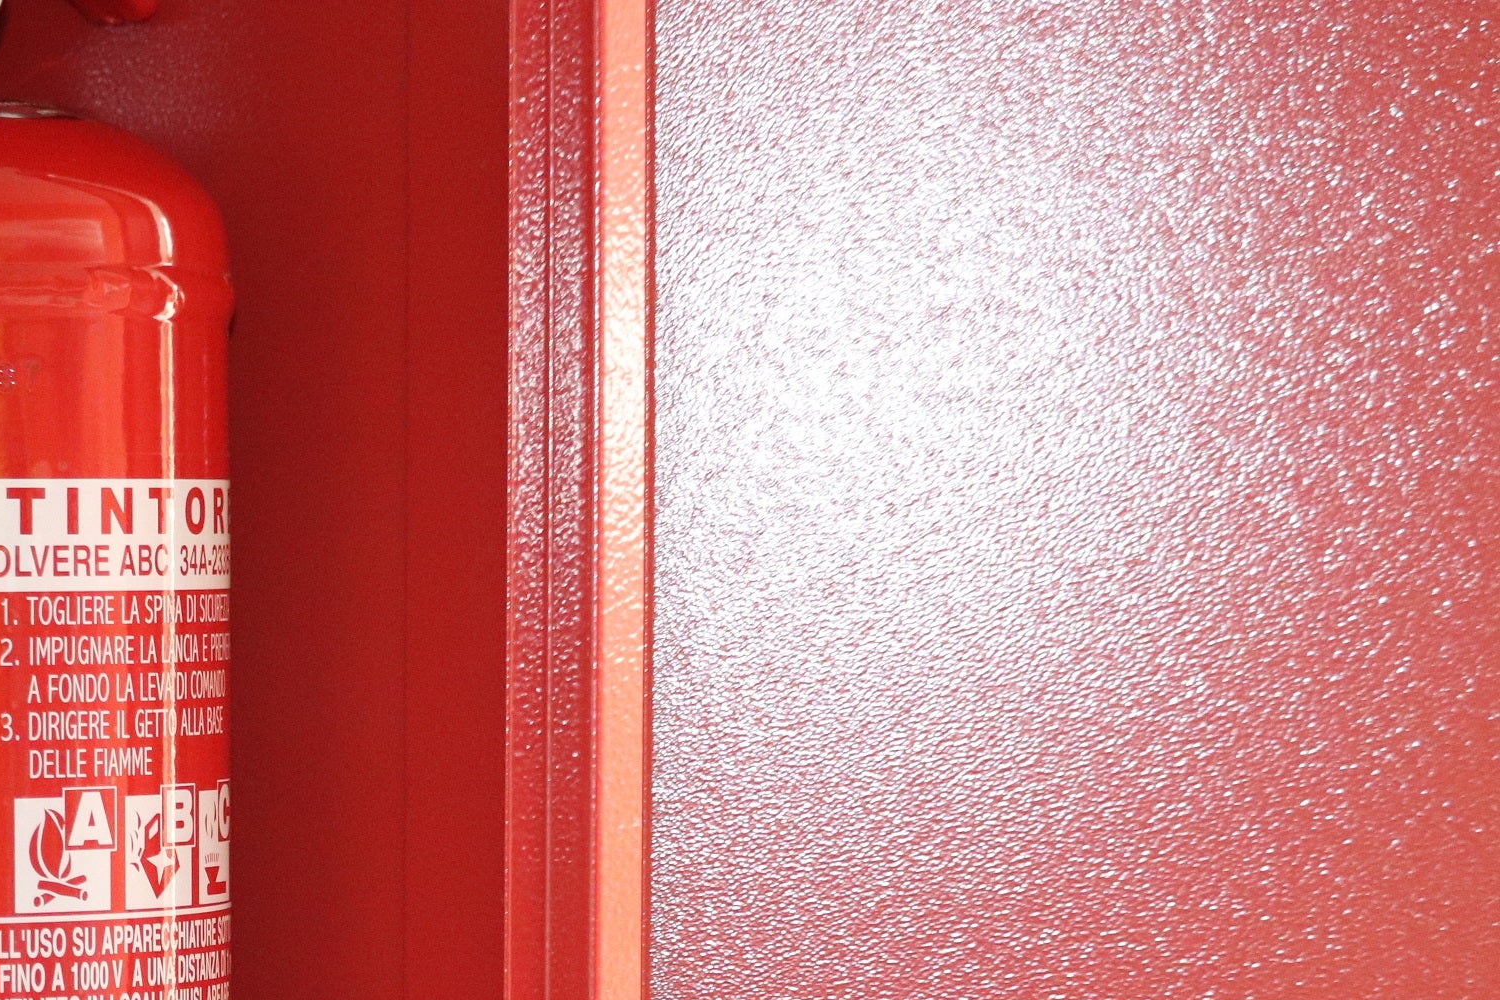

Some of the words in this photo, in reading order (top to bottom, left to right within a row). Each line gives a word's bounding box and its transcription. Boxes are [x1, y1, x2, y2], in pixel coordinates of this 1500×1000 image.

[119, 544, 168, 577] ABC
[1, 598, 18, 626] 1.
[27, 596, 115, 625] TOGLIERE
[121, 596, 140, 624] LA
[145, 595, 183, 624] SPINA
[187, 594, 196, 622] DI
[0, 638, 19, 666] 2.
[29, 636, 134, 666] IMPUGNARE
[140, 635, 157, 664] LA
[161, 634, 199, 664] LANCIA
[27, 674, 41, 703] A
[49, 673, 109, 703] FONDO
[116, 673, 135, 702] LA
[140, 672, 172, 701] LEVA
[176, 672, 187, 700] DI
[1, 713, 19, 741] 3.
[28, 711, 110, 741] DIRIGERE
[117, 710, 130, 739] IL
[135, 708, 177, 738] GETTO
[180, 707, 203, 737] ALLA
[206, 706, 224, 735] BASE
[29, 749, 87, 779] DELLE
[94, 747, 152, 777] FIAMME
[68, 791, 113, 846] A
[166, 789, 194, 844] B
[72, 926, 96, 957] SU
[101, 919, 216, 956] APPARECCHIATURE
[0, 962, 46, 993] FINO
[51, 962, 65, 992] A
[70, 961, 109, 991] 1000
[112, 959, 123, 989] V
[132, 958, 143, 988] A
[148, 956, 175, 987] UNA
[178, 950, 219, 984] DISTANZA
